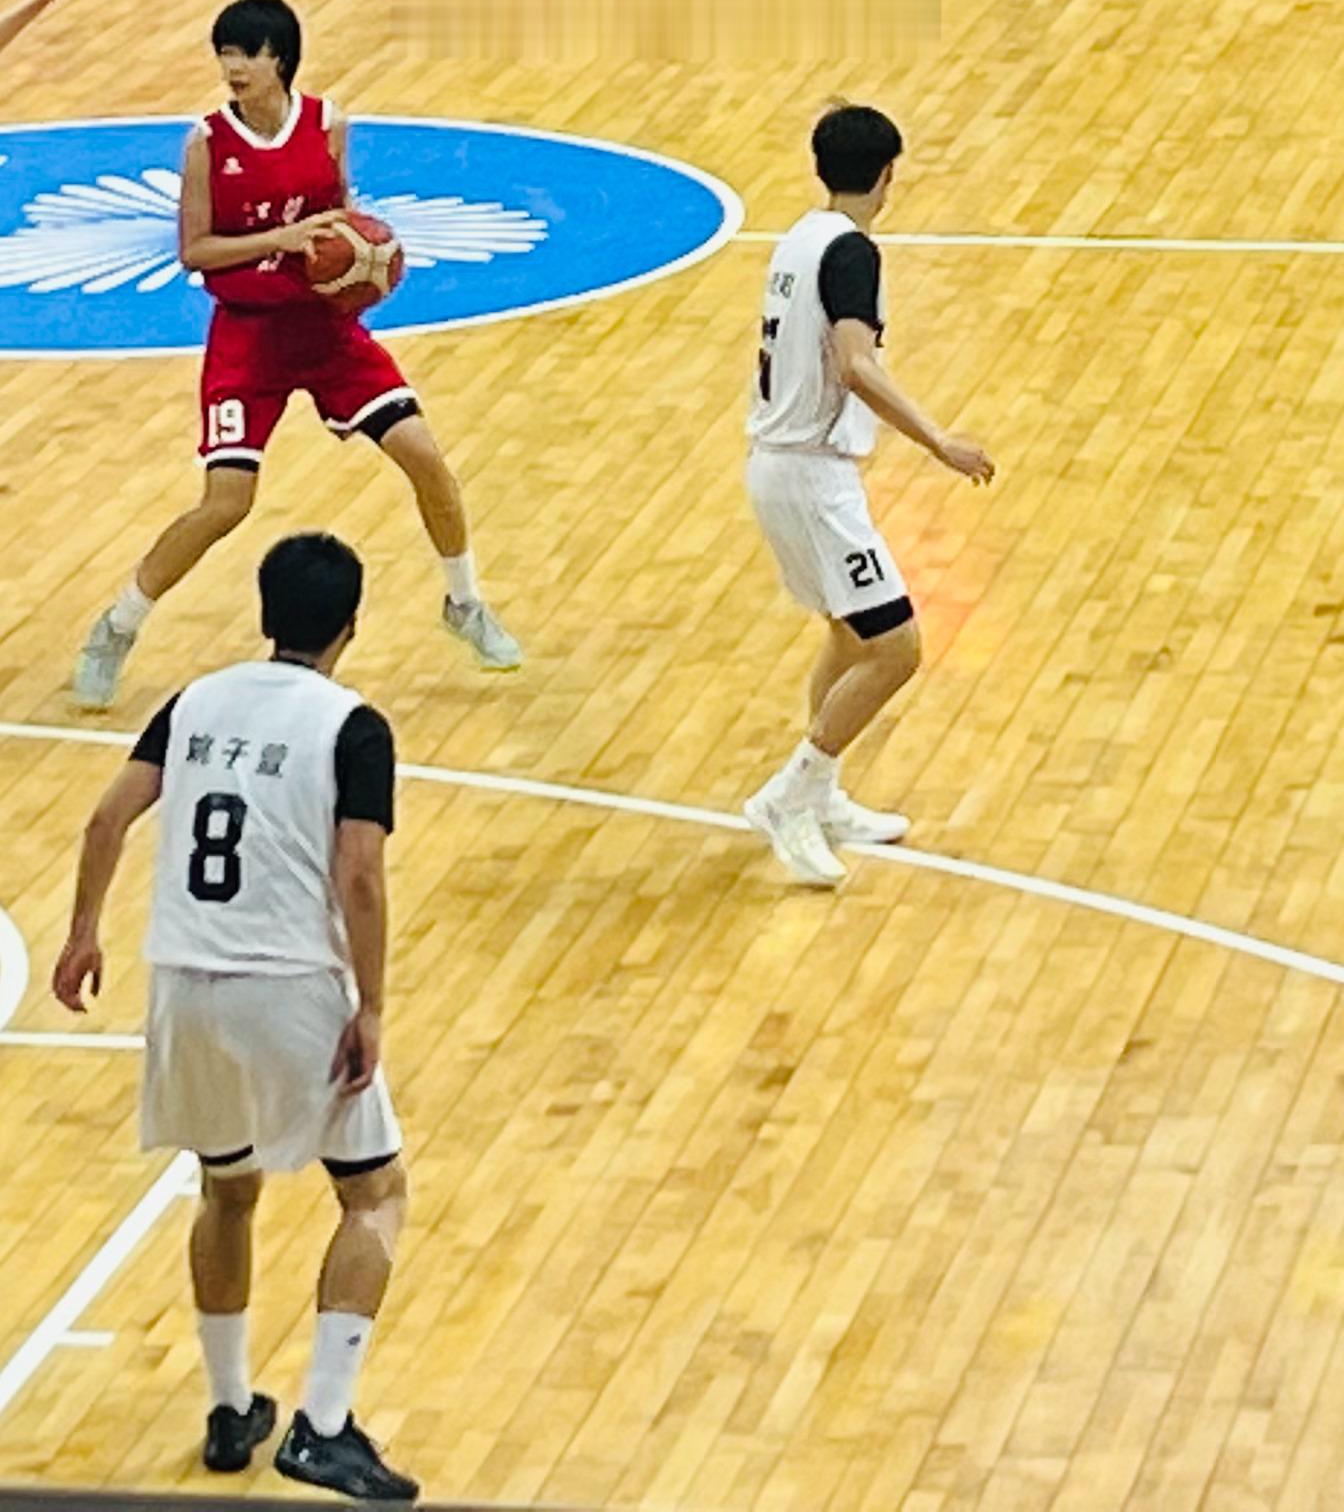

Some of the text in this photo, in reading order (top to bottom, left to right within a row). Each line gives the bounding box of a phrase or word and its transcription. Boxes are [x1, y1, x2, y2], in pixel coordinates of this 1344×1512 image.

[208, 398, 246, 448] 19
[844, 547, 886, 590] 21
[187, 791, 248, 904] 8
